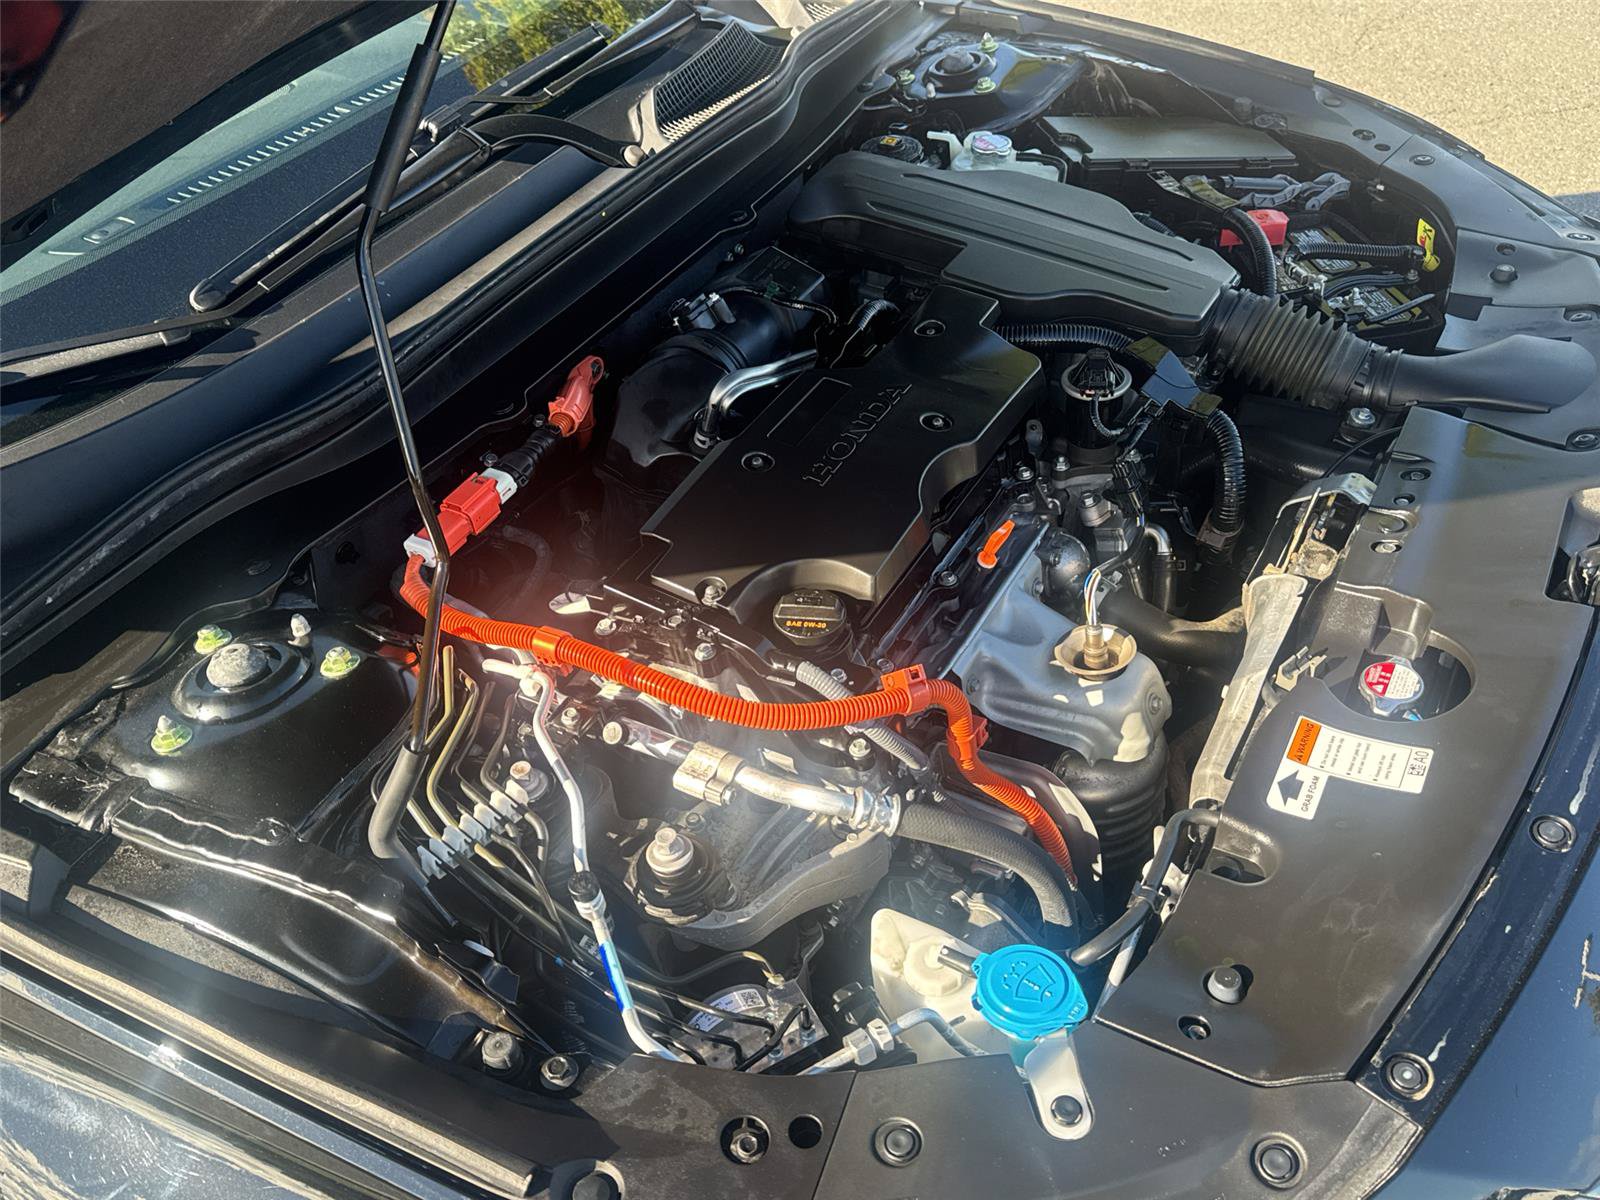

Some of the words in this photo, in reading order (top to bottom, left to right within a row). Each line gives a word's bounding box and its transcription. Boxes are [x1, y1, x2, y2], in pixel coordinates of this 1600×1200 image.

[802, 383, 913, 487] HONDA
[785, 620, 802, 628] SAE
[1297, 722, 1314, 754] WARNING
[1300, 793, 1314, 812] GRAB
[1307, 775, 1320, 794] FOAM
